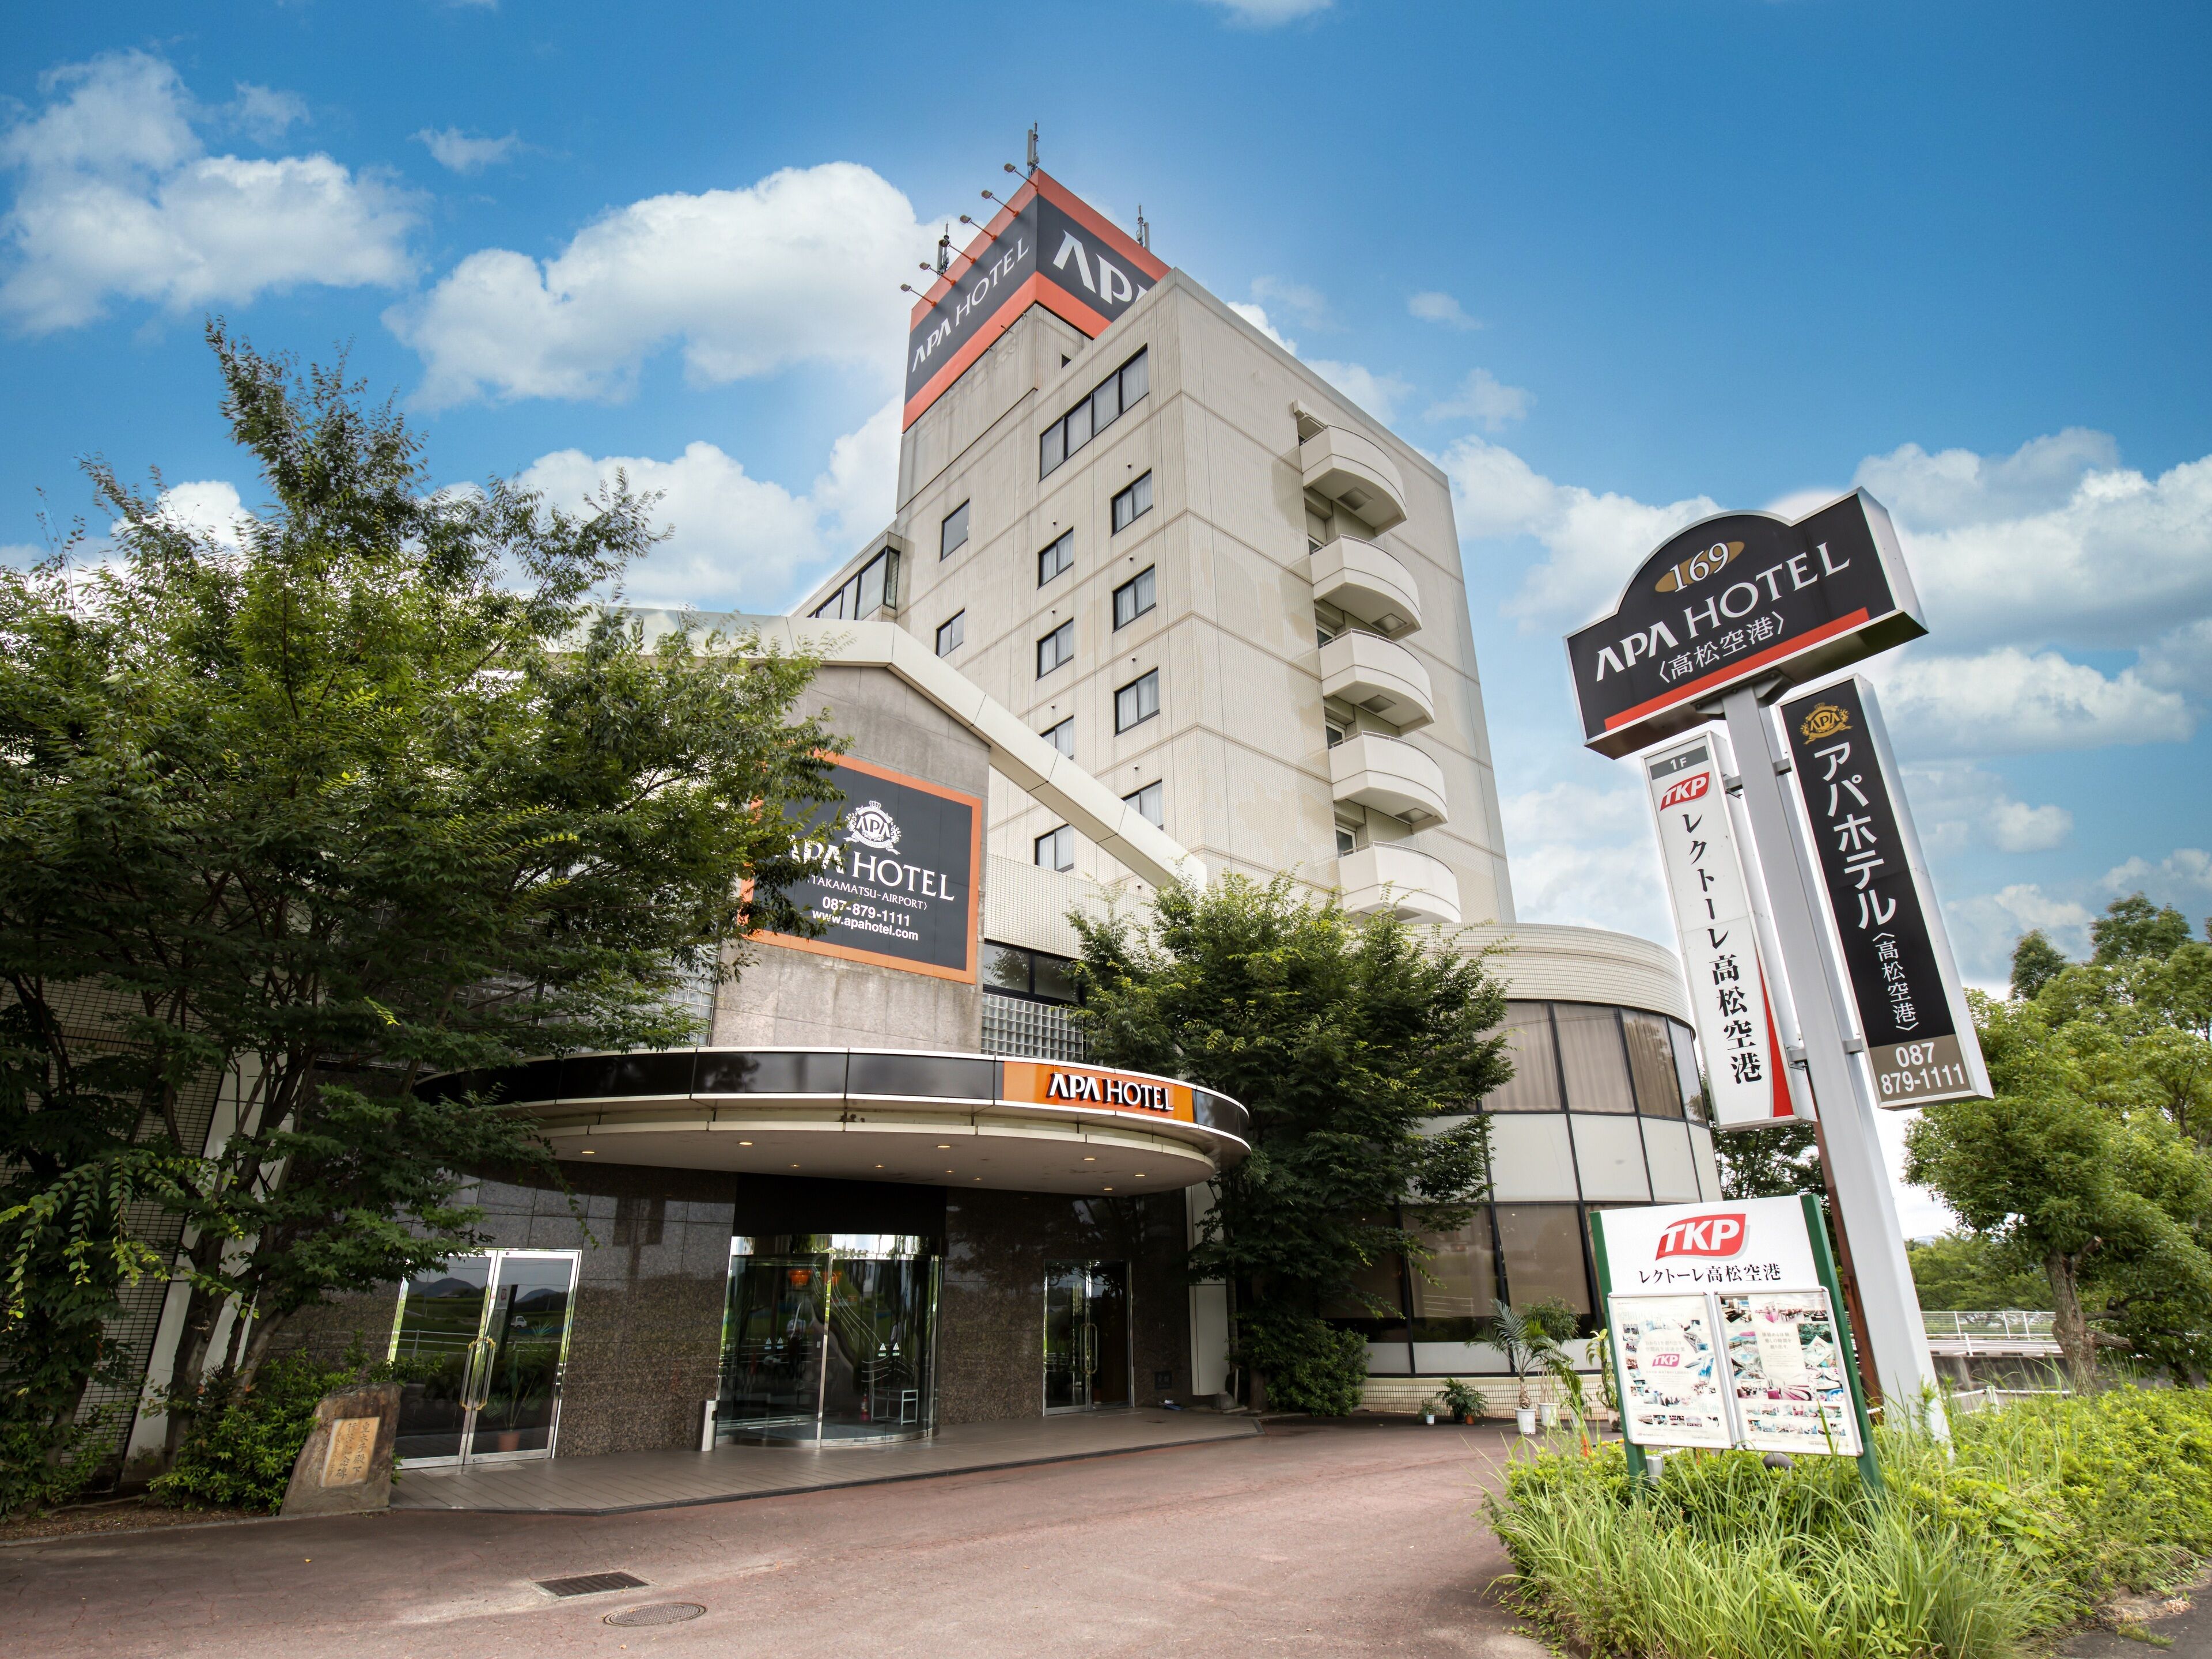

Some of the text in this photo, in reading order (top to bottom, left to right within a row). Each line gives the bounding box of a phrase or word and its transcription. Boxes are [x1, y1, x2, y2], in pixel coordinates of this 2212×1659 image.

[912, 237, 1029, 373] APA HOTEL
[1669, 541, 1729, 593] 169
[1596, 541, 1850, 682] APA HOTEL
[1810, 711, 1841, 732] APA
[1662, 776, 1707, 806] TKP
[856, 815, 891, 838] APA
[1814, 741, 1896, 930] アパホテル
[852, 850, 955, 902] HOTEL
[812, 910, 919, 941] www.apahotel.com
[822, 896, 910, 927] 087-879-1111
[1681, 814, 1763, 1085] レクトーレ高松空港
[1895, 1041, 1935, 1068] 087
[1048, 1073, 1175, 1111] APA HOTEL
[1880, 1063, 1965, 1095] 879-1111
[1663, 1218, 1740, 1253] TKP
[1639, 1263, 1782, 1285] レクトーレ高松空港
[1654, 1354, 1679, 1366] TKP
